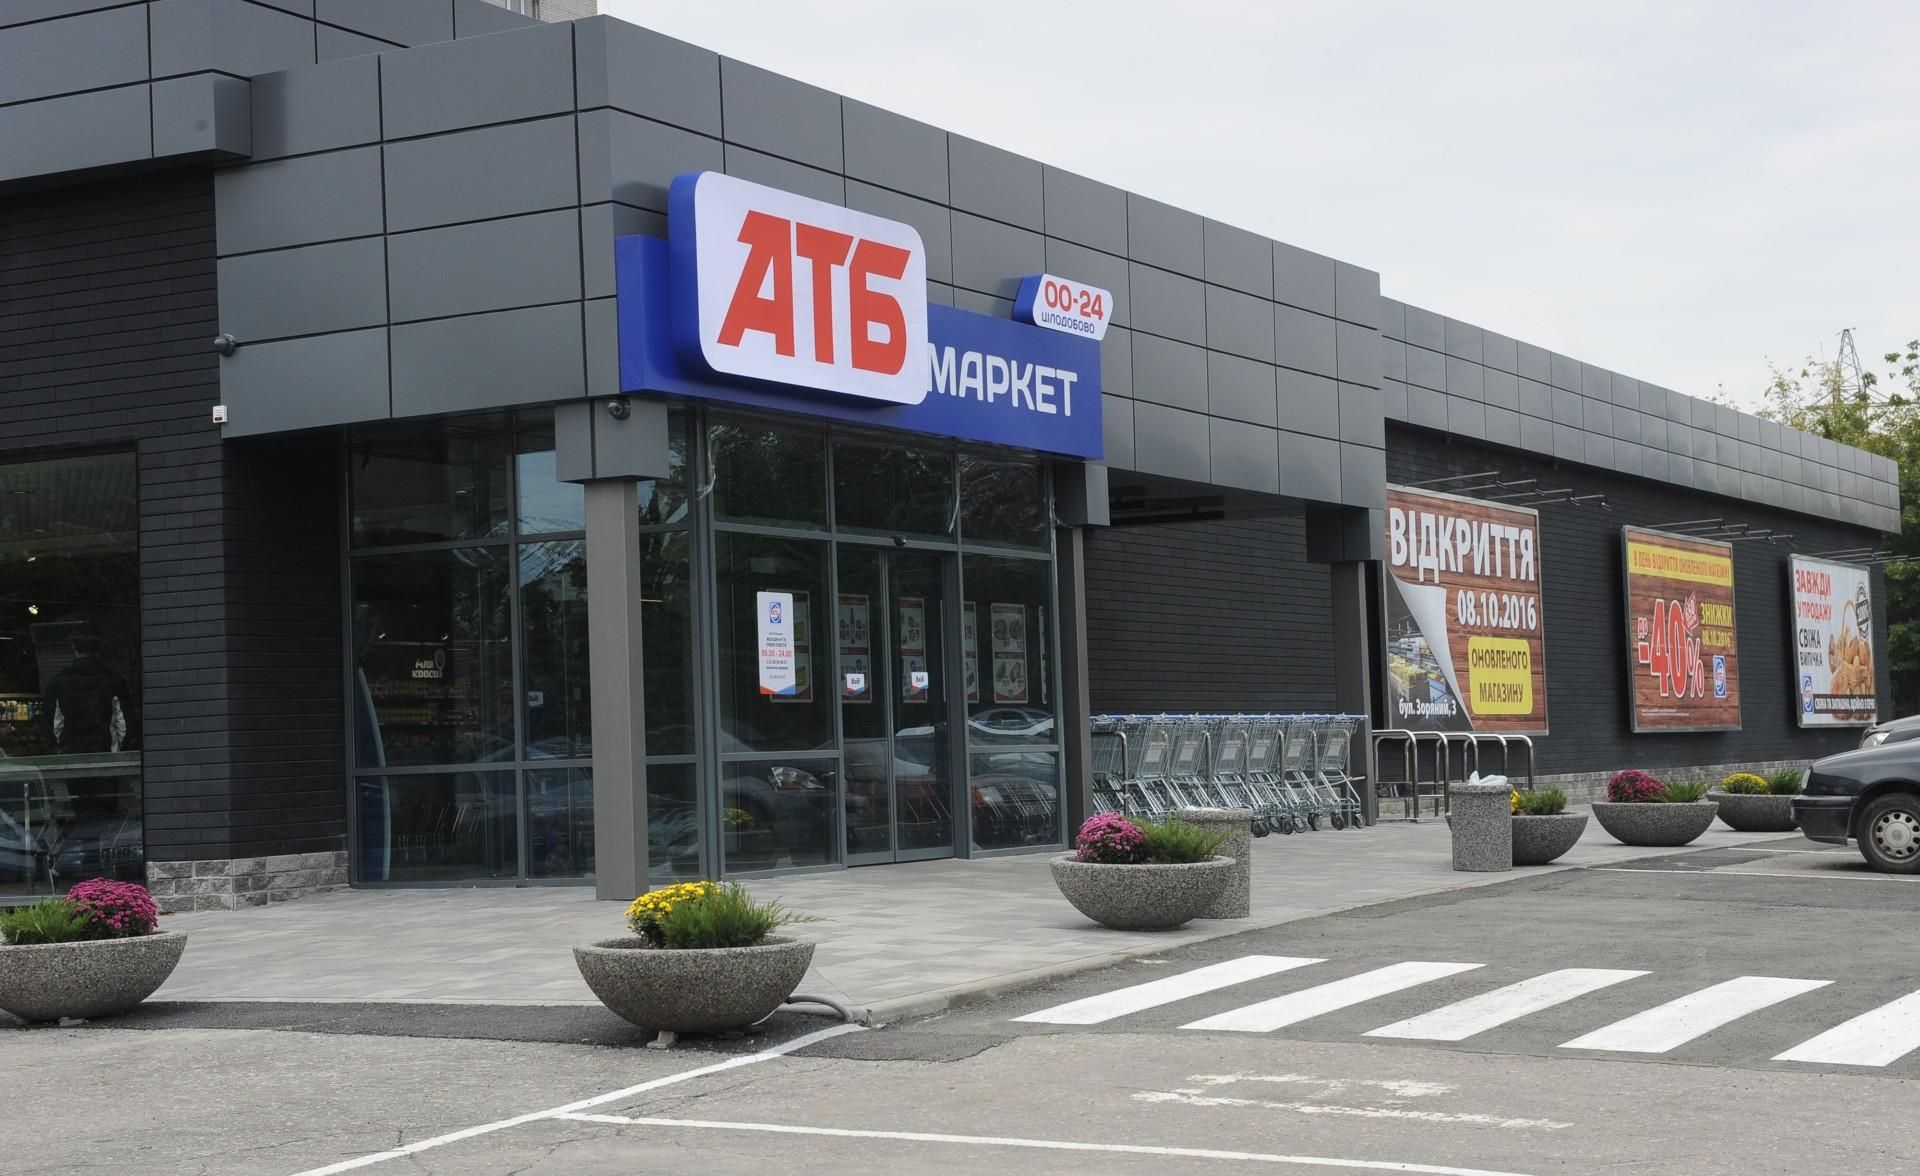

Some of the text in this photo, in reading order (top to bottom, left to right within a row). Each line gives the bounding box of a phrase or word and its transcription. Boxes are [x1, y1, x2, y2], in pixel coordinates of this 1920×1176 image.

[717, 210, 911, 375] АТБ
[1045, 280, 1104, 321] 00-24
[927, 343, 1078, 417] МАРКЕТ
[1389, 507, 1536, 584] ВІДКРИТТЯ
[1795, 570, 1831, 601] ЗАВЖДИ
[1457, 589, 1537, 630] 08.10.2016
[1701, 602, 1732, 627] ЗНИЖКИ
[1802, 601, 1831, 623] ПРОДАЖУ
[1799, 629, 1821, 649] СВІЖА
[1471, 648, 1528, 670] ОНОВЛЕНОГО
[1479, 682, 1523, 703] МАГАЗИНУ
[1399, 697, 1457, 719] бул. Зоряний, 3
